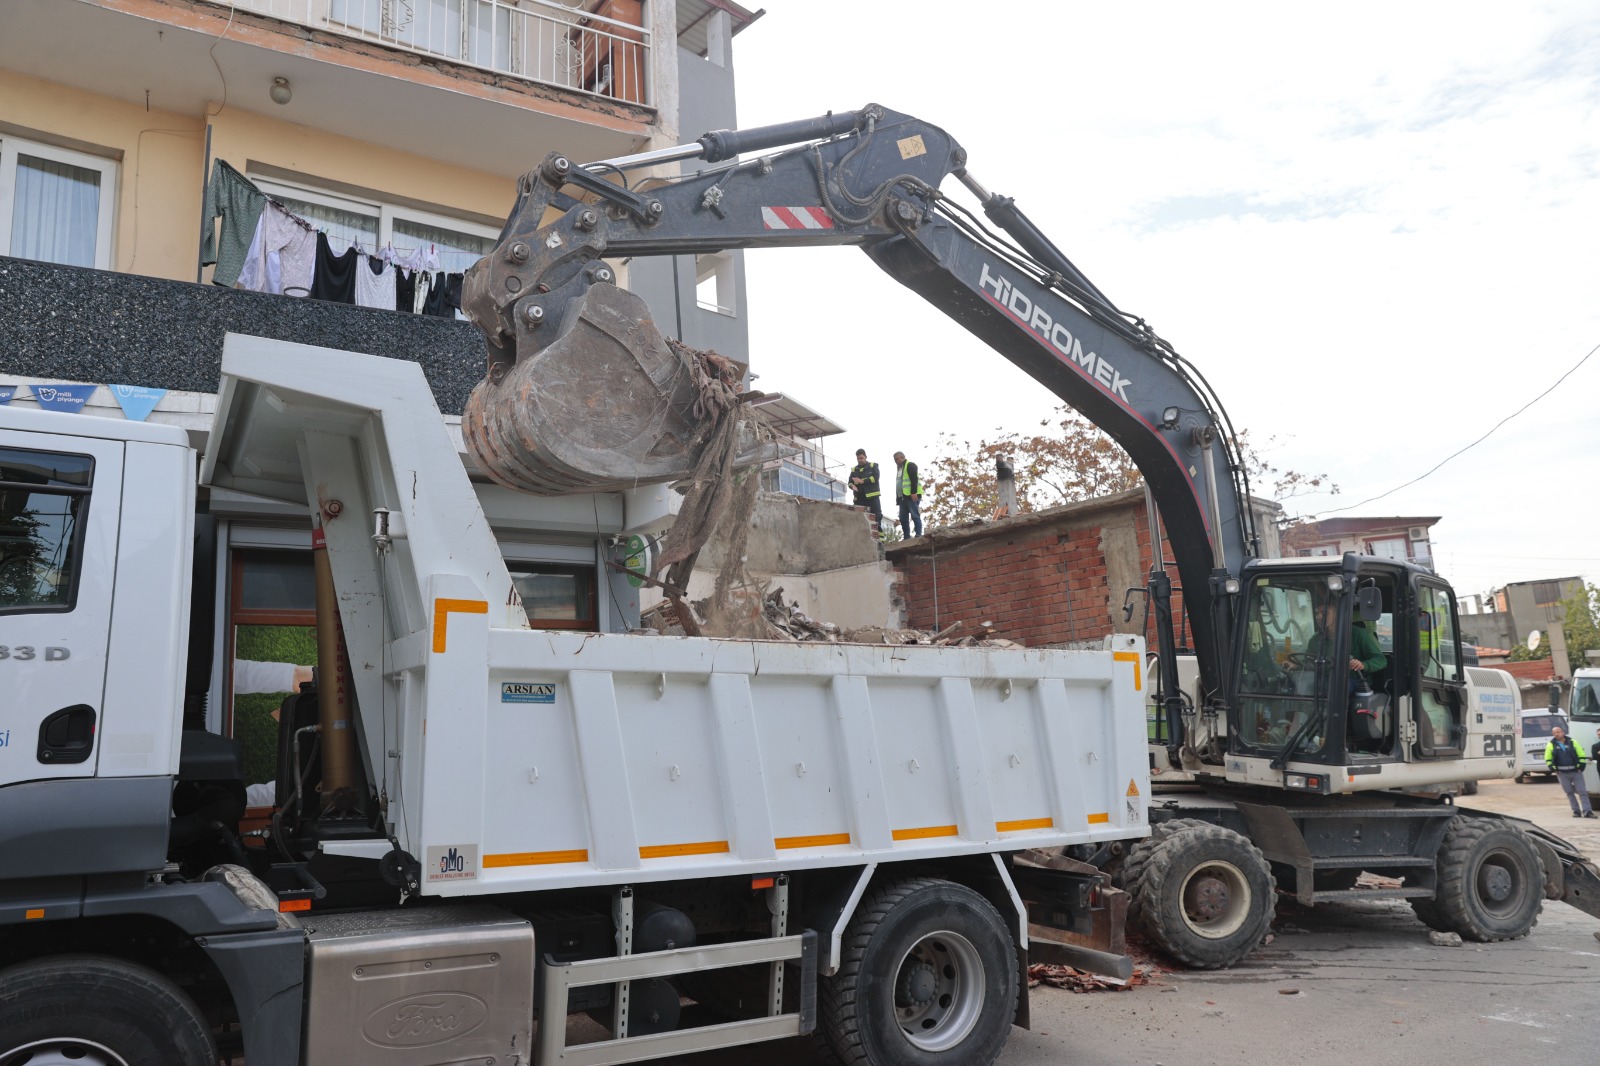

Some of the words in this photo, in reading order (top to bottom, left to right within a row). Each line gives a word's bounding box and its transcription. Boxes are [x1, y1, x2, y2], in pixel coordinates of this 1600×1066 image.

[44, 646, 70, 661] D
[505, 684, 553, 695] ARSLAN
[1500, 724, 1514, 732] HMK
[1484, 734, 1514, 756] 200
[1507, 760, 1515, 769] W
[440, 848, 464, 873] DMO
[386, 1001, 465, 1038] Ford
